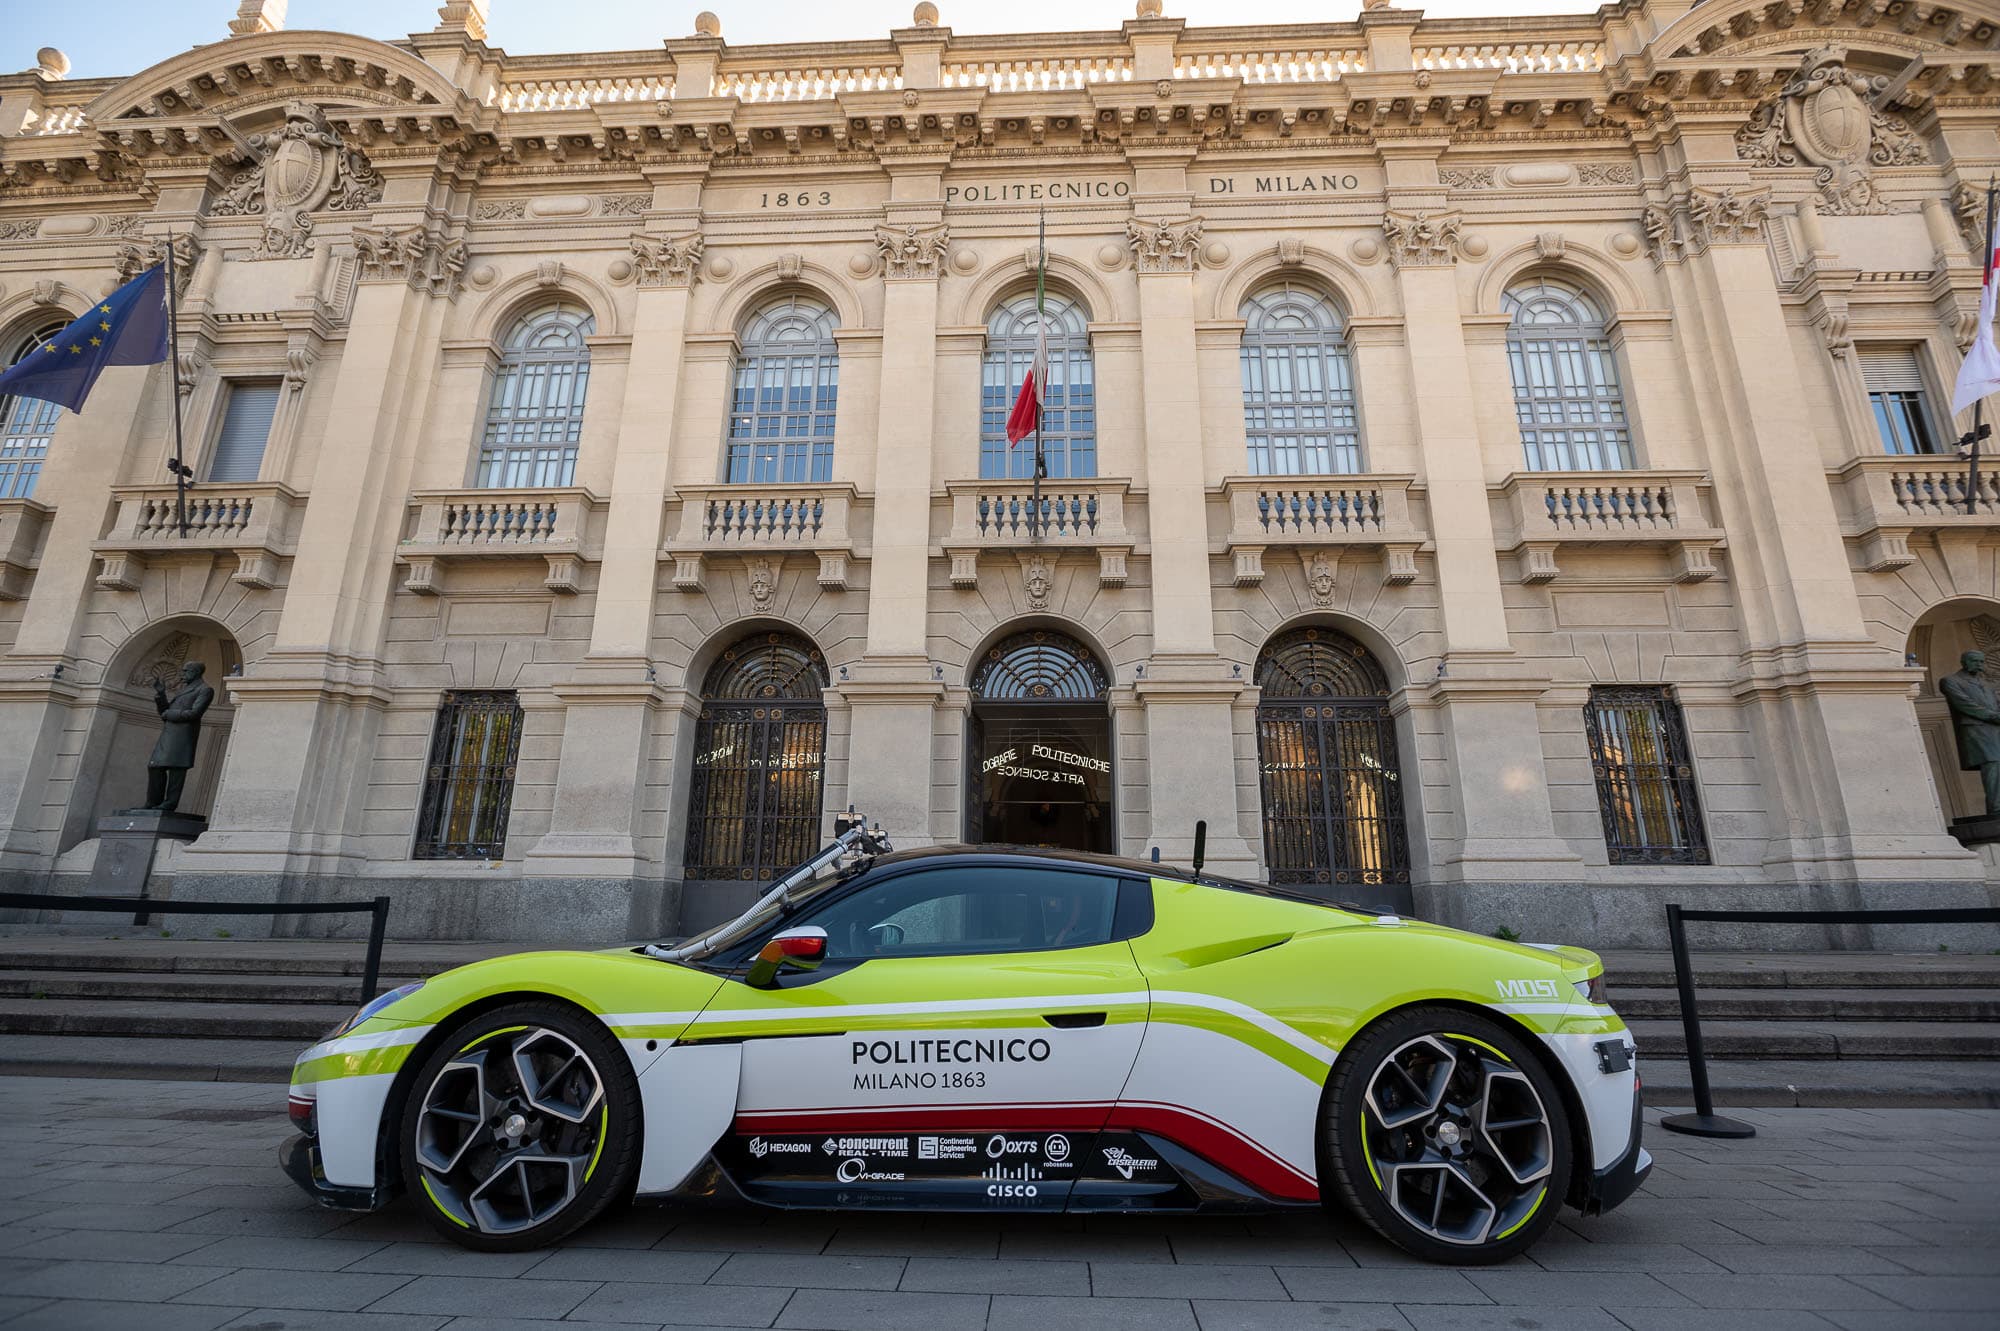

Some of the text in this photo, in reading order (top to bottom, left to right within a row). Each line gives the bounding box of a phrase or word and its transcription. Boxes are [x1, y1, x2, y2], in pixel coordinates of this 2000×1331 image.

[1210, 174, 1358, 193] DI MILANO
[946, 181, 1129, 202] POLITECNICO
[761, 191, 831, 208] 1863
[1031, 744, 1111, 773] POLITECNICHE
[852, 1038, 1051, 1065] POLITECNICO
[853, 1071, 986, 1090] MILANO 1863
[770, 1143, 811, 1153] HEXAGON
[939, 1137, 974, 1146] Continental
[939, 1144, 977, 1153] Engineering
[939, 1151, 965, 1159] Services
[858, 1172, 905, 1180] VI-GRADE
[987, 1185, 1038, 1197] CISCO
